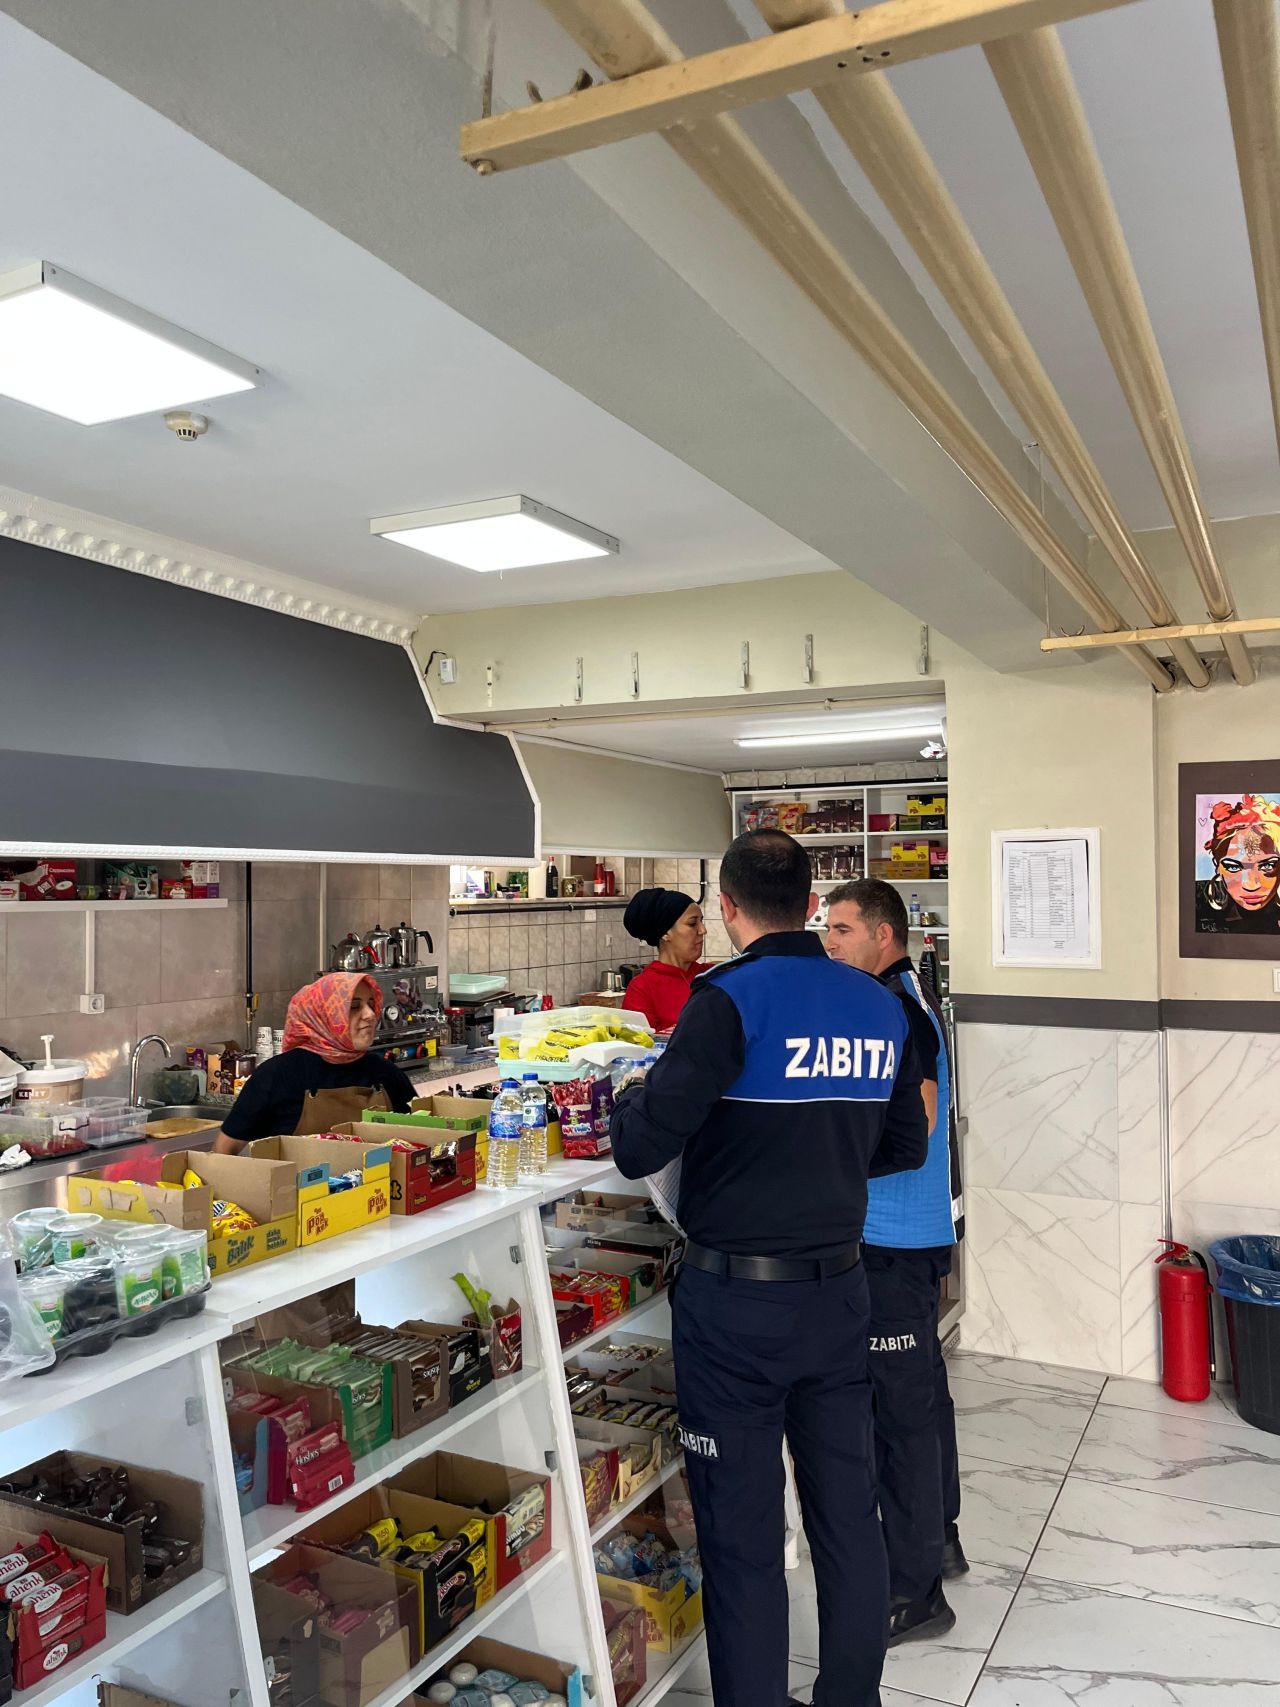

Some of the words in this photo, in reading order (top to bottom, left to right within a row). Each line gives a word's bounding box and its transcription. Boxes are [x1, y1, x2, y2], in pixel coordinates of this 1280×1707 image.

[785, 1037, 895, 1079] ZABITA
[869, 1333, 917, 1352] ZABITA
[678, 1426, 718, 1458] ZABITA
